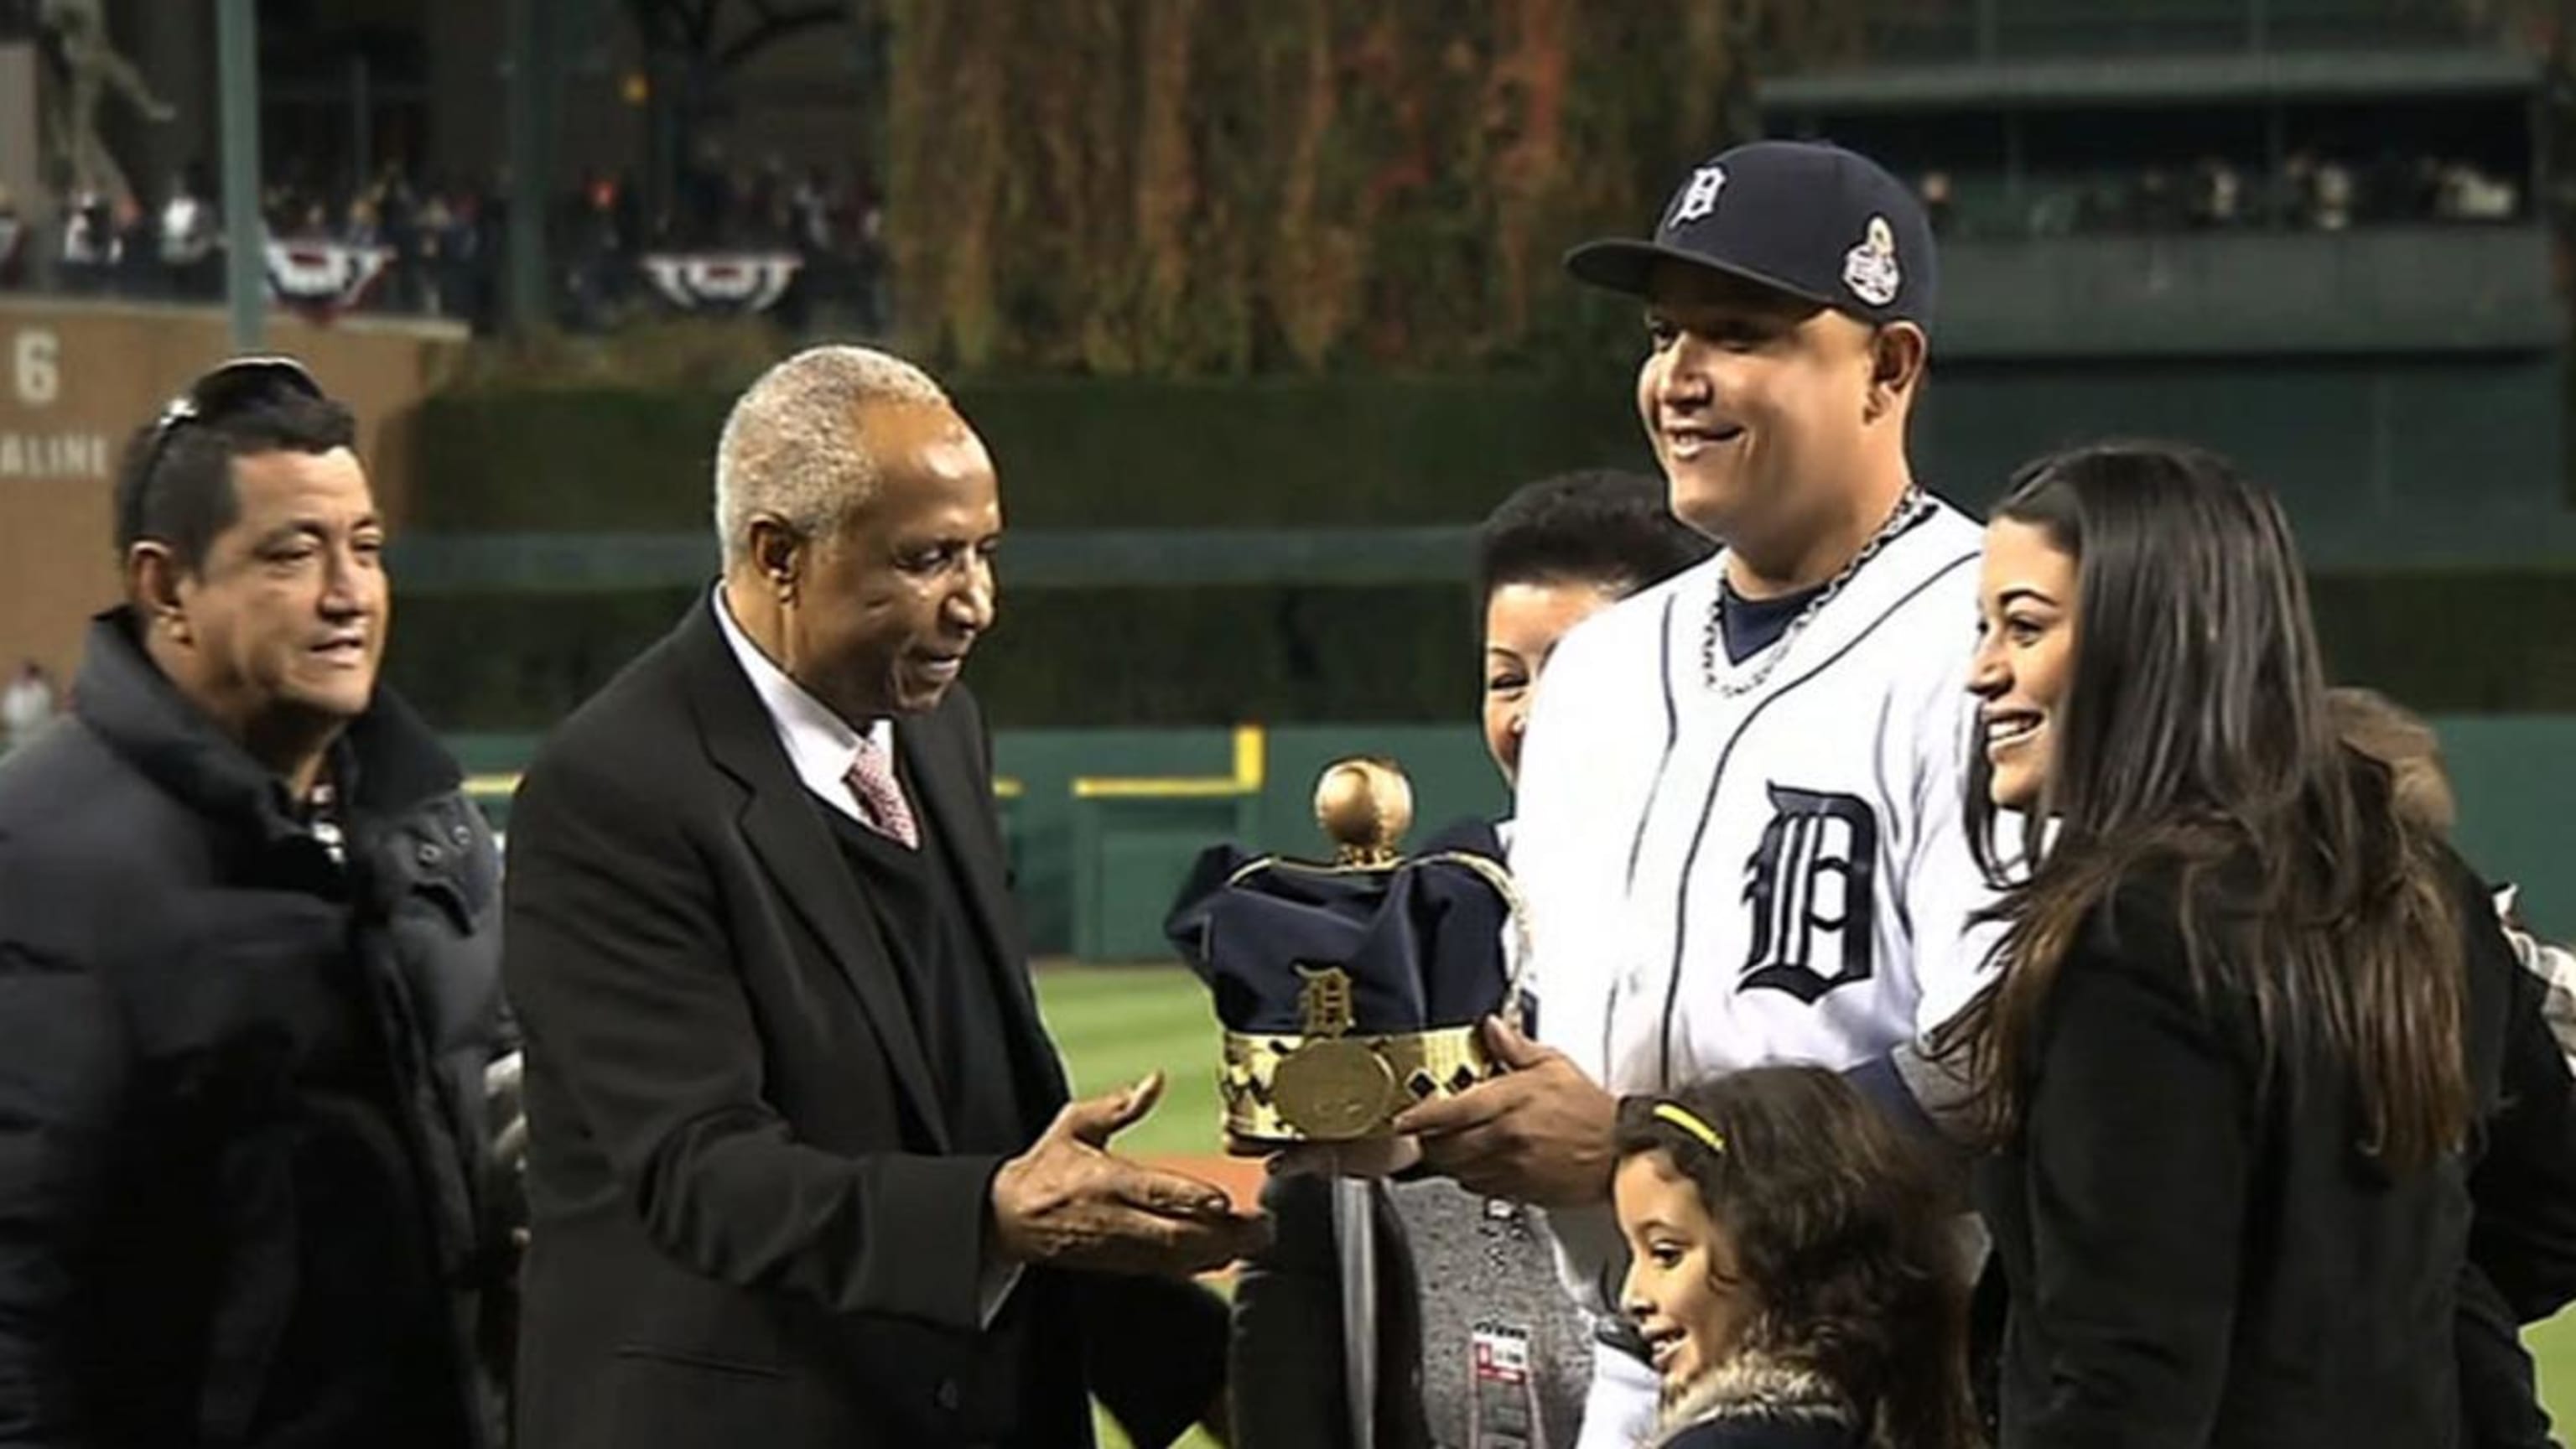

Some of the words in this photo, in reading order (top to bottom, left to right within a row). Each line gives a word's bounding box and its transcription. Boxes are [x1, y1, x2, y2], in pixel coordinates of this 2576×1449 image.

[1668, 167, 1726, 230] D
[16, 331, 58, 405] 6
[1734, 779, 1876, 1005] D
